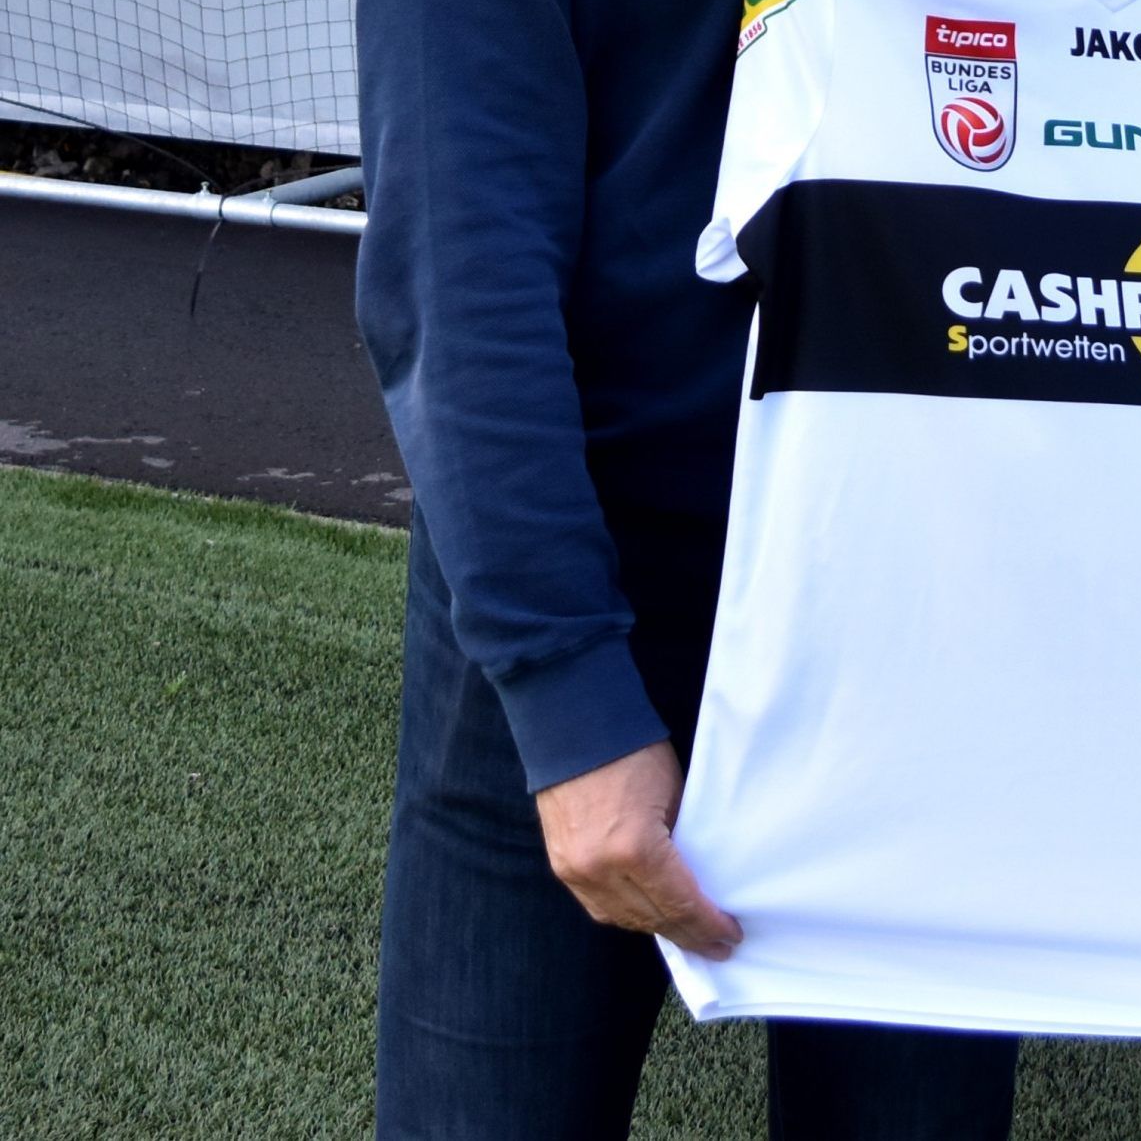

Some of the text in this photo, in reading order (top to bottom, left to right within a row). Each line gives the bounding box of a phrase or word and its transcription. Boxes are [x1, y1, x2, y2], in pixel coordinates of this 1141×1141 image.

[936, 25, 1008, 47] tipico
[931, 60, 1012, 80] BUNDES
[948, 77, 993, 94] LIGA
[947, 325, 1126, 362] Sportwetten
